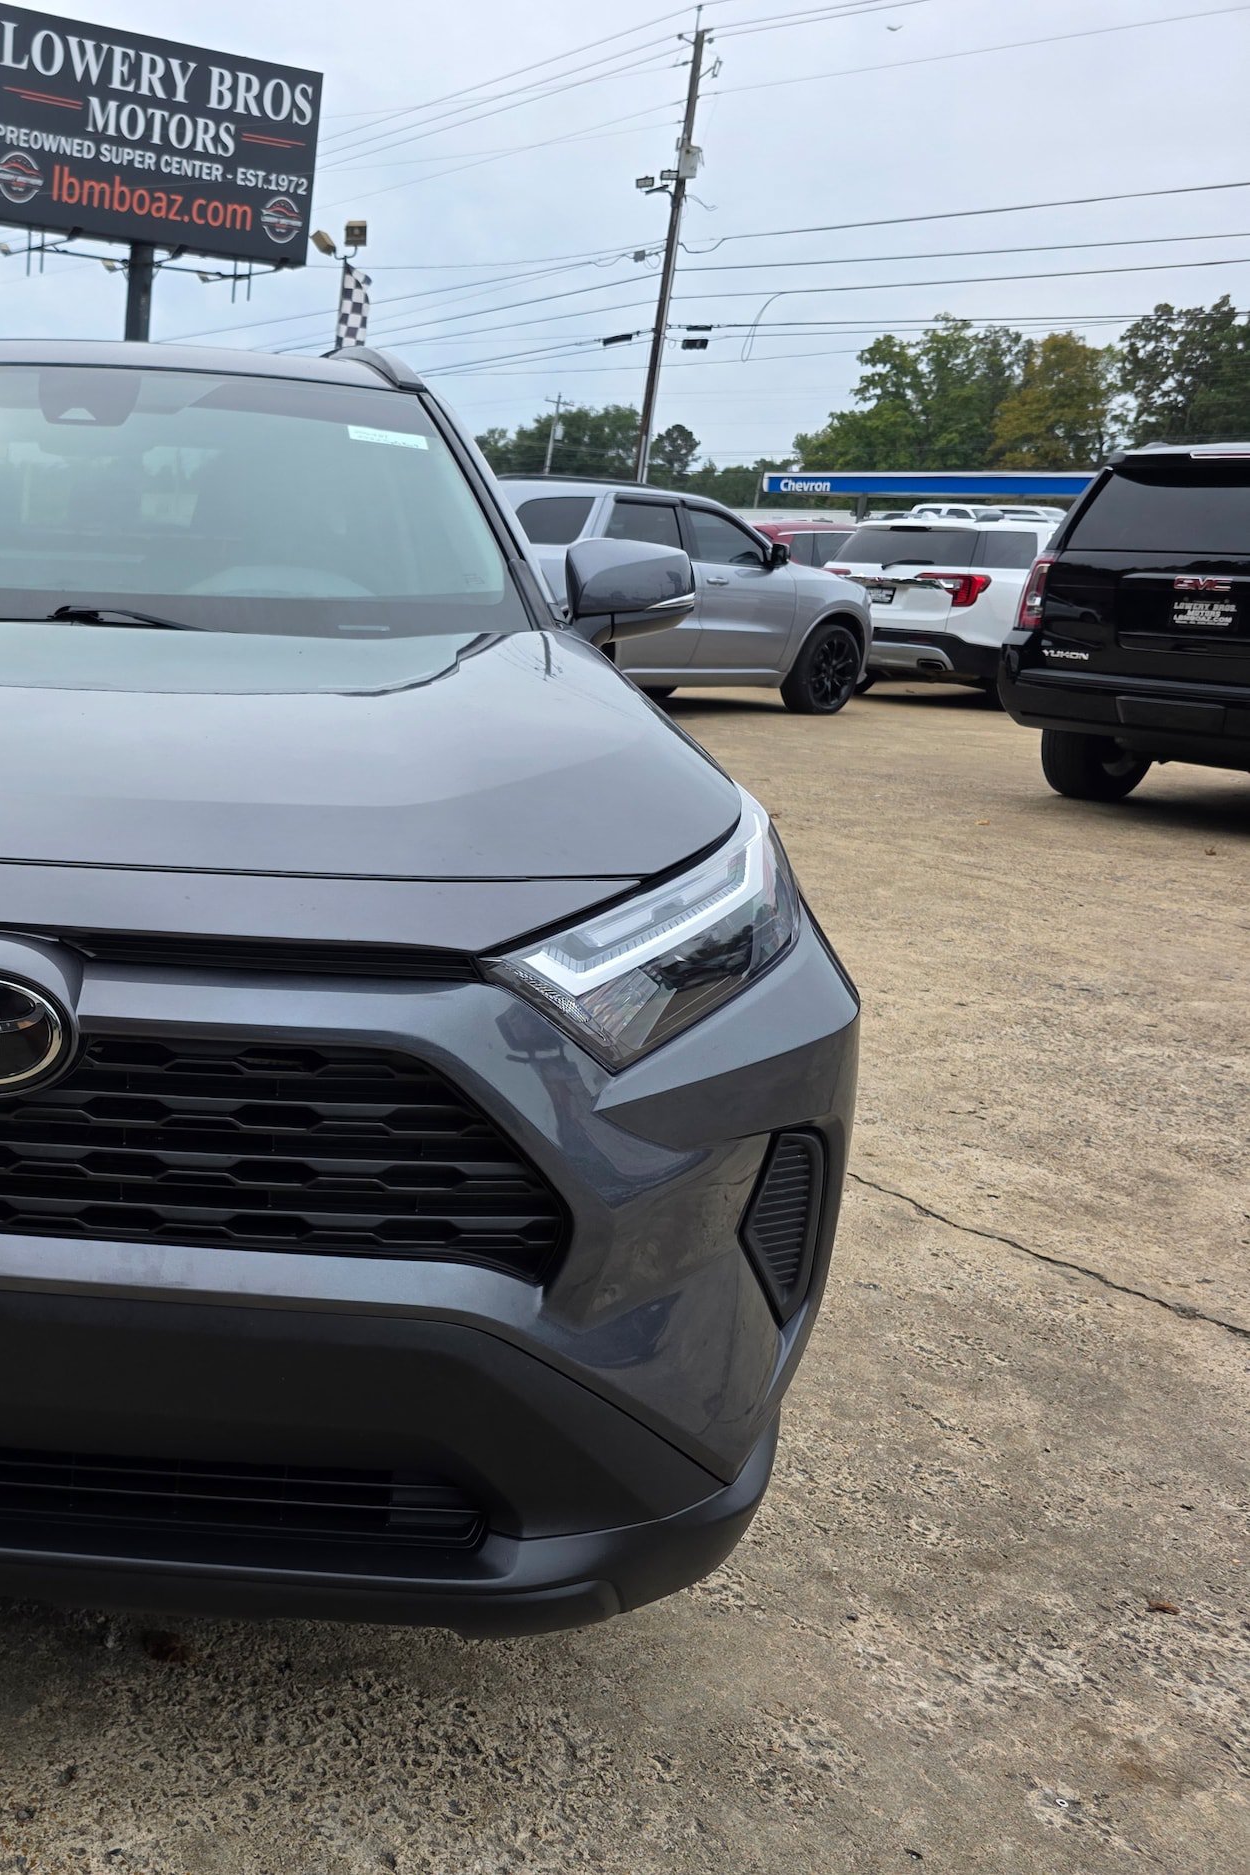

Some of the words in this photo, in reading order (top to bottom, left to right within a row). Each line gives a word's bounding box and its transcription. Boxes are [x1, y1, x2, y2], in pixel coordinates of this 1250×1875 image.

[0, 20, 197, 104] LOWERY
[206, 67, 313, 126] BROS
[86, 97, 236, 158] MOTORS
[100, 144, 156, 172] SUPER
[160, 155, 222, 183] CENTER
[236, 167, 307, 196] EST.1972
[52, 165, 252, 231] lbmboaz.com
[780, 478, 831, 492] Chevron
[1174, 576, 1233, 591] GMC
[1042, 649, 1090, 660] YUKON
